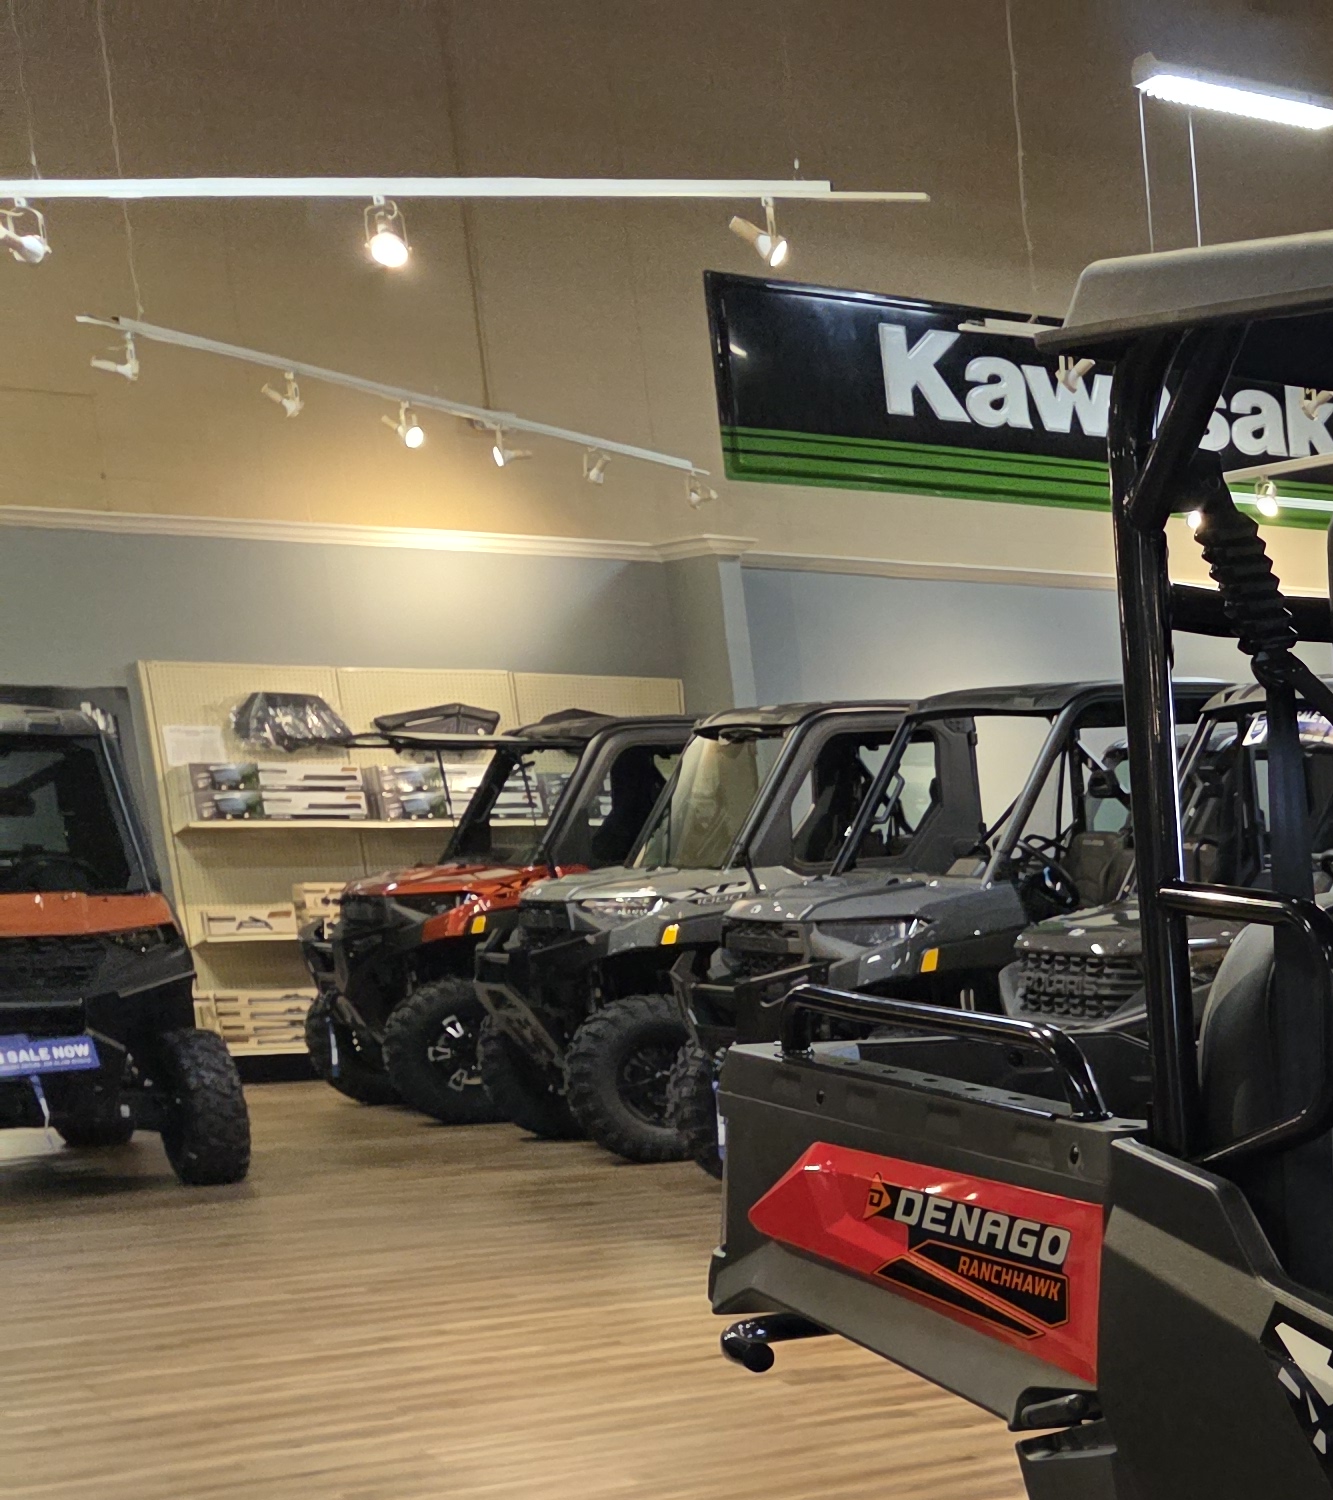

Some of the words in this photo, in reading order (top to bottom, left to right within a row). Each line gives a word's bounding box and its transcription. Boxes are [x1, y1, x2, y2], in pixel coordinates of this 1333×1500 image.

[7, 1047, 51, 1064] SALE
[52, 1042, 89, 1060] NOW
[894, 1189, 1071, 1265] DENAGO
[958, 1255, 1061, 1301] RANCHHAWK
